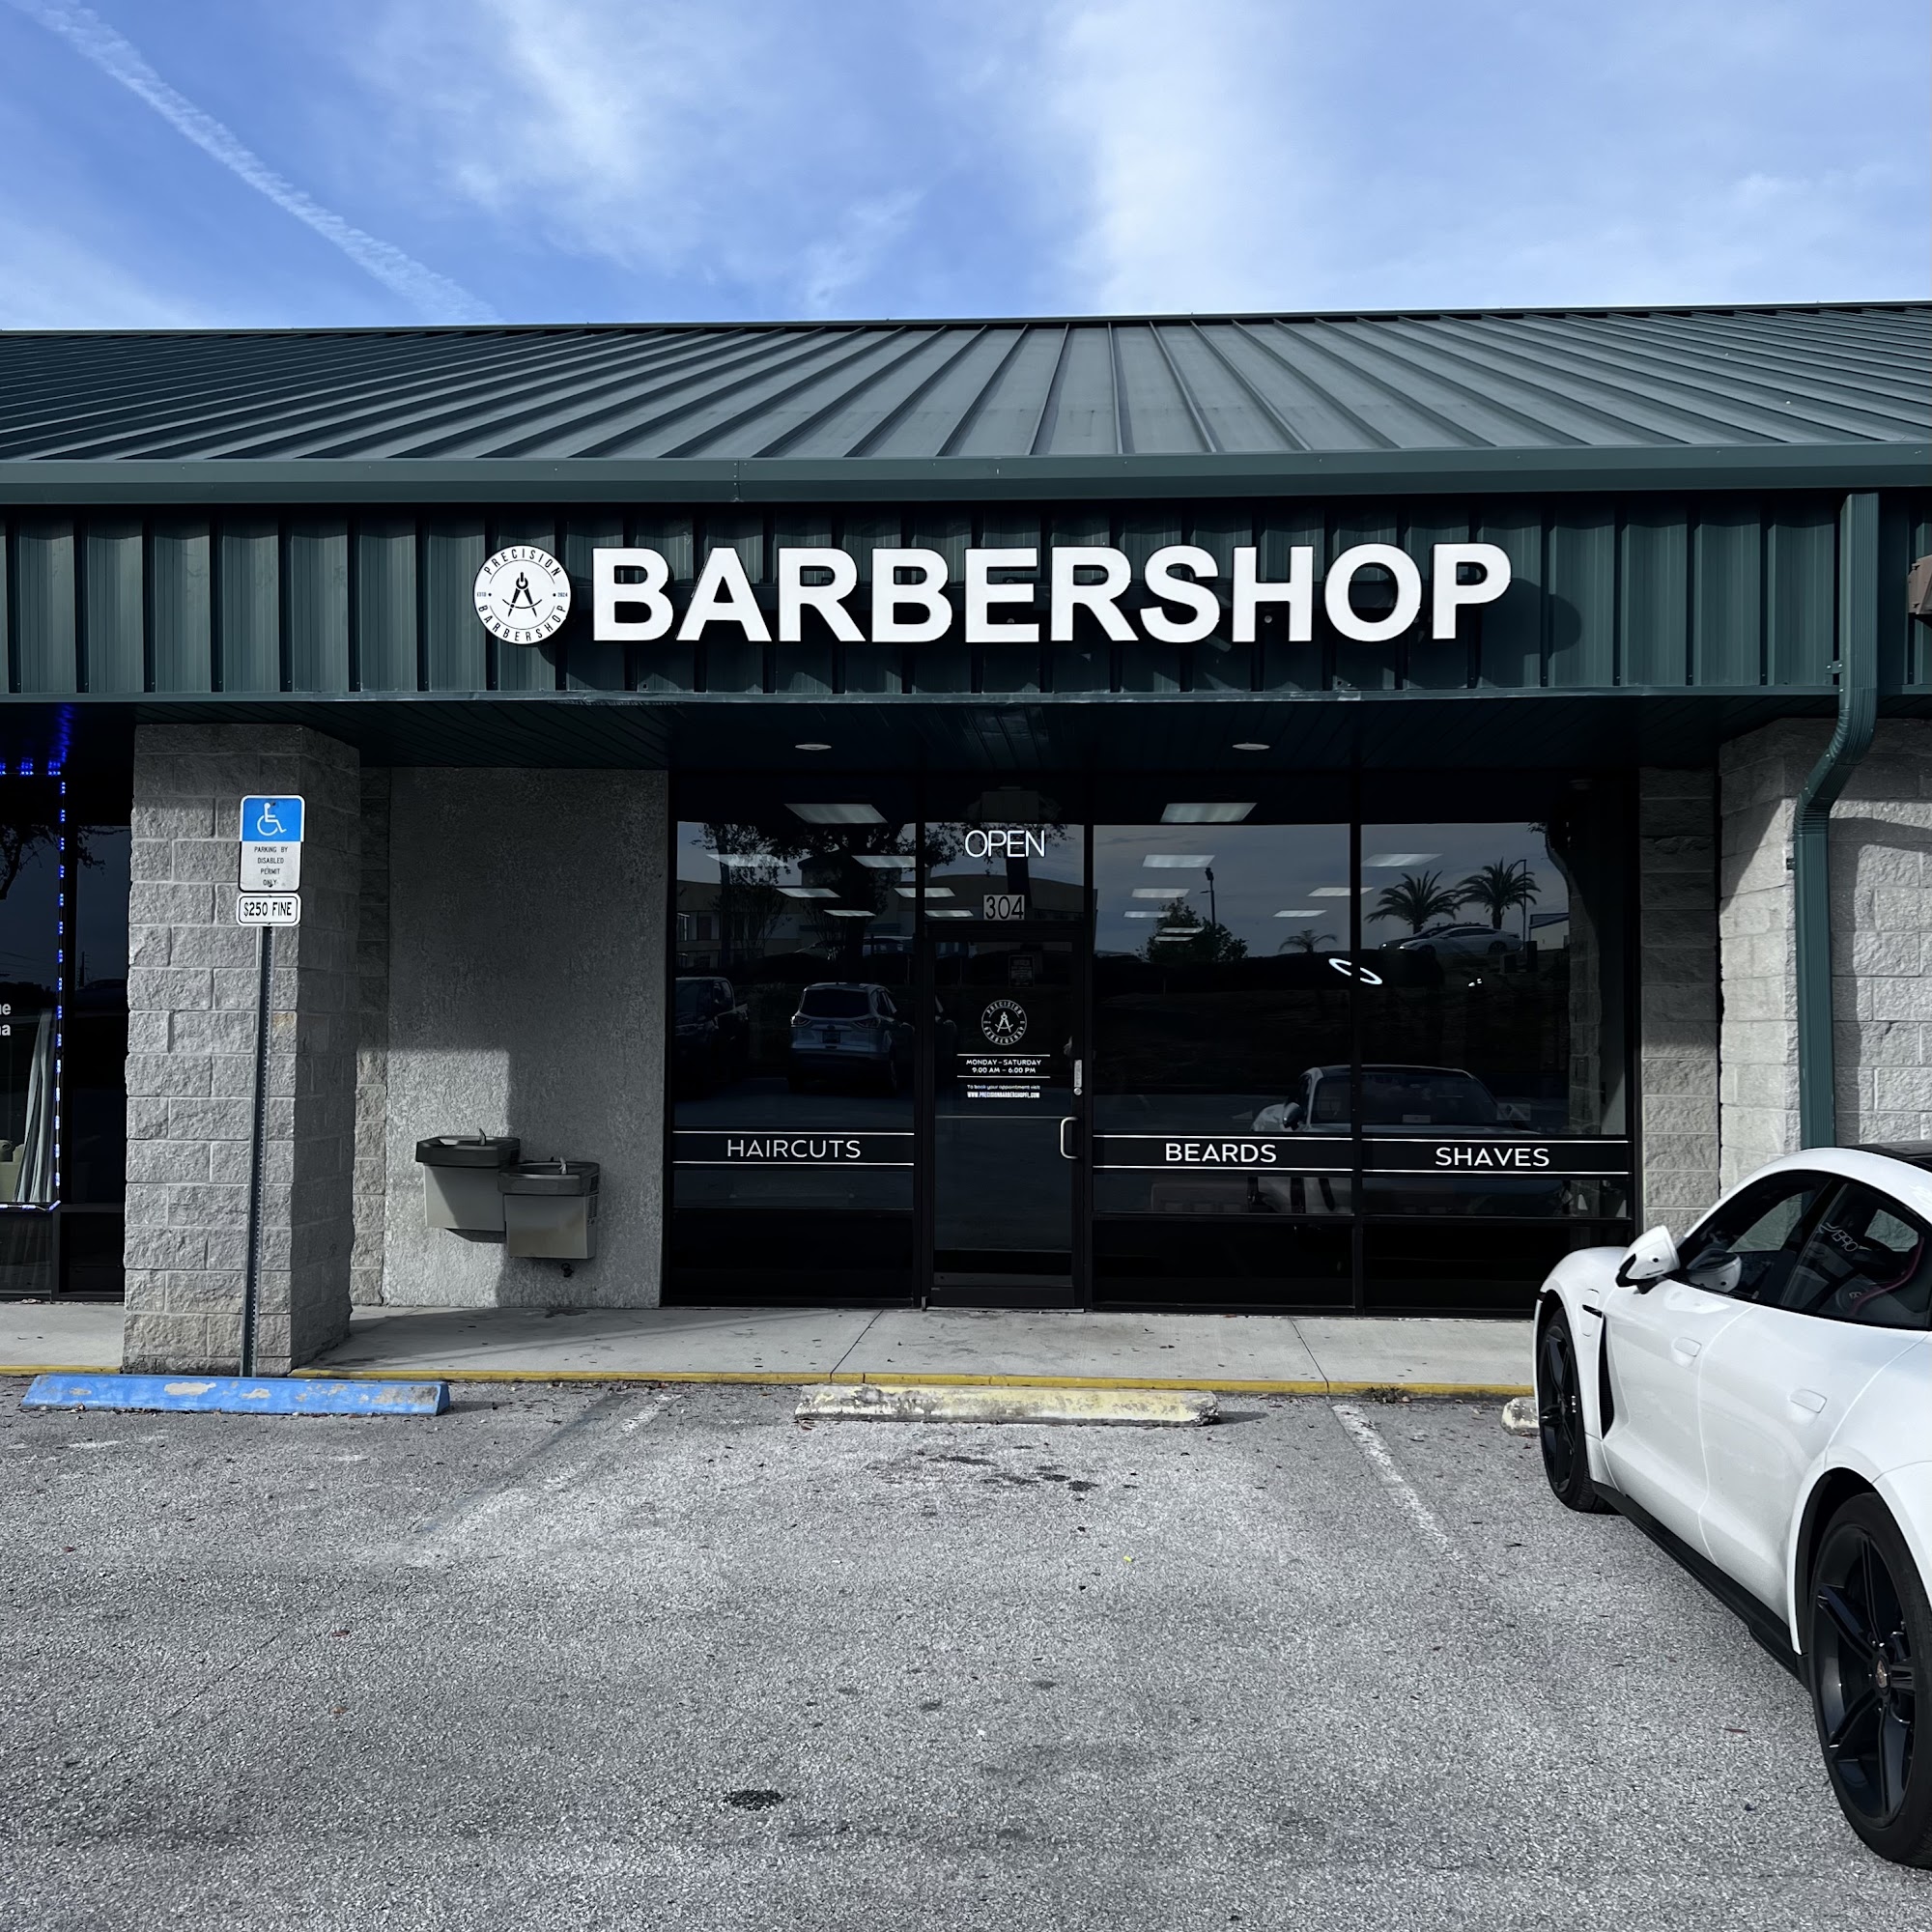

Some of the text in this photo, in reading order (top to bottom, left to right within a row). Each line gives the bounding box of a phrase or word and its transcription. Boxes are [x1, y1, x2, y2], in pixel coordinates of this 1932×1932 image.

[483, 548, 561, 577] PRECISION
[592, 543, 1512, 644] BARBERSHOP
[478, 605, 566, 641] BARBERSHOP
[965, 830, 1045, 858] OPEN
[243, 901, 293, 917] $250 FINE
[985, 895, 1024, 920] 304
[0, 1024, 12, 1037] a
[727, 1139, 862, 1159] HAIRCUTS
[1164, 1142, 1277, 1164] BEARDS
[1435, 1147, 1550, 1167] SHAVES
